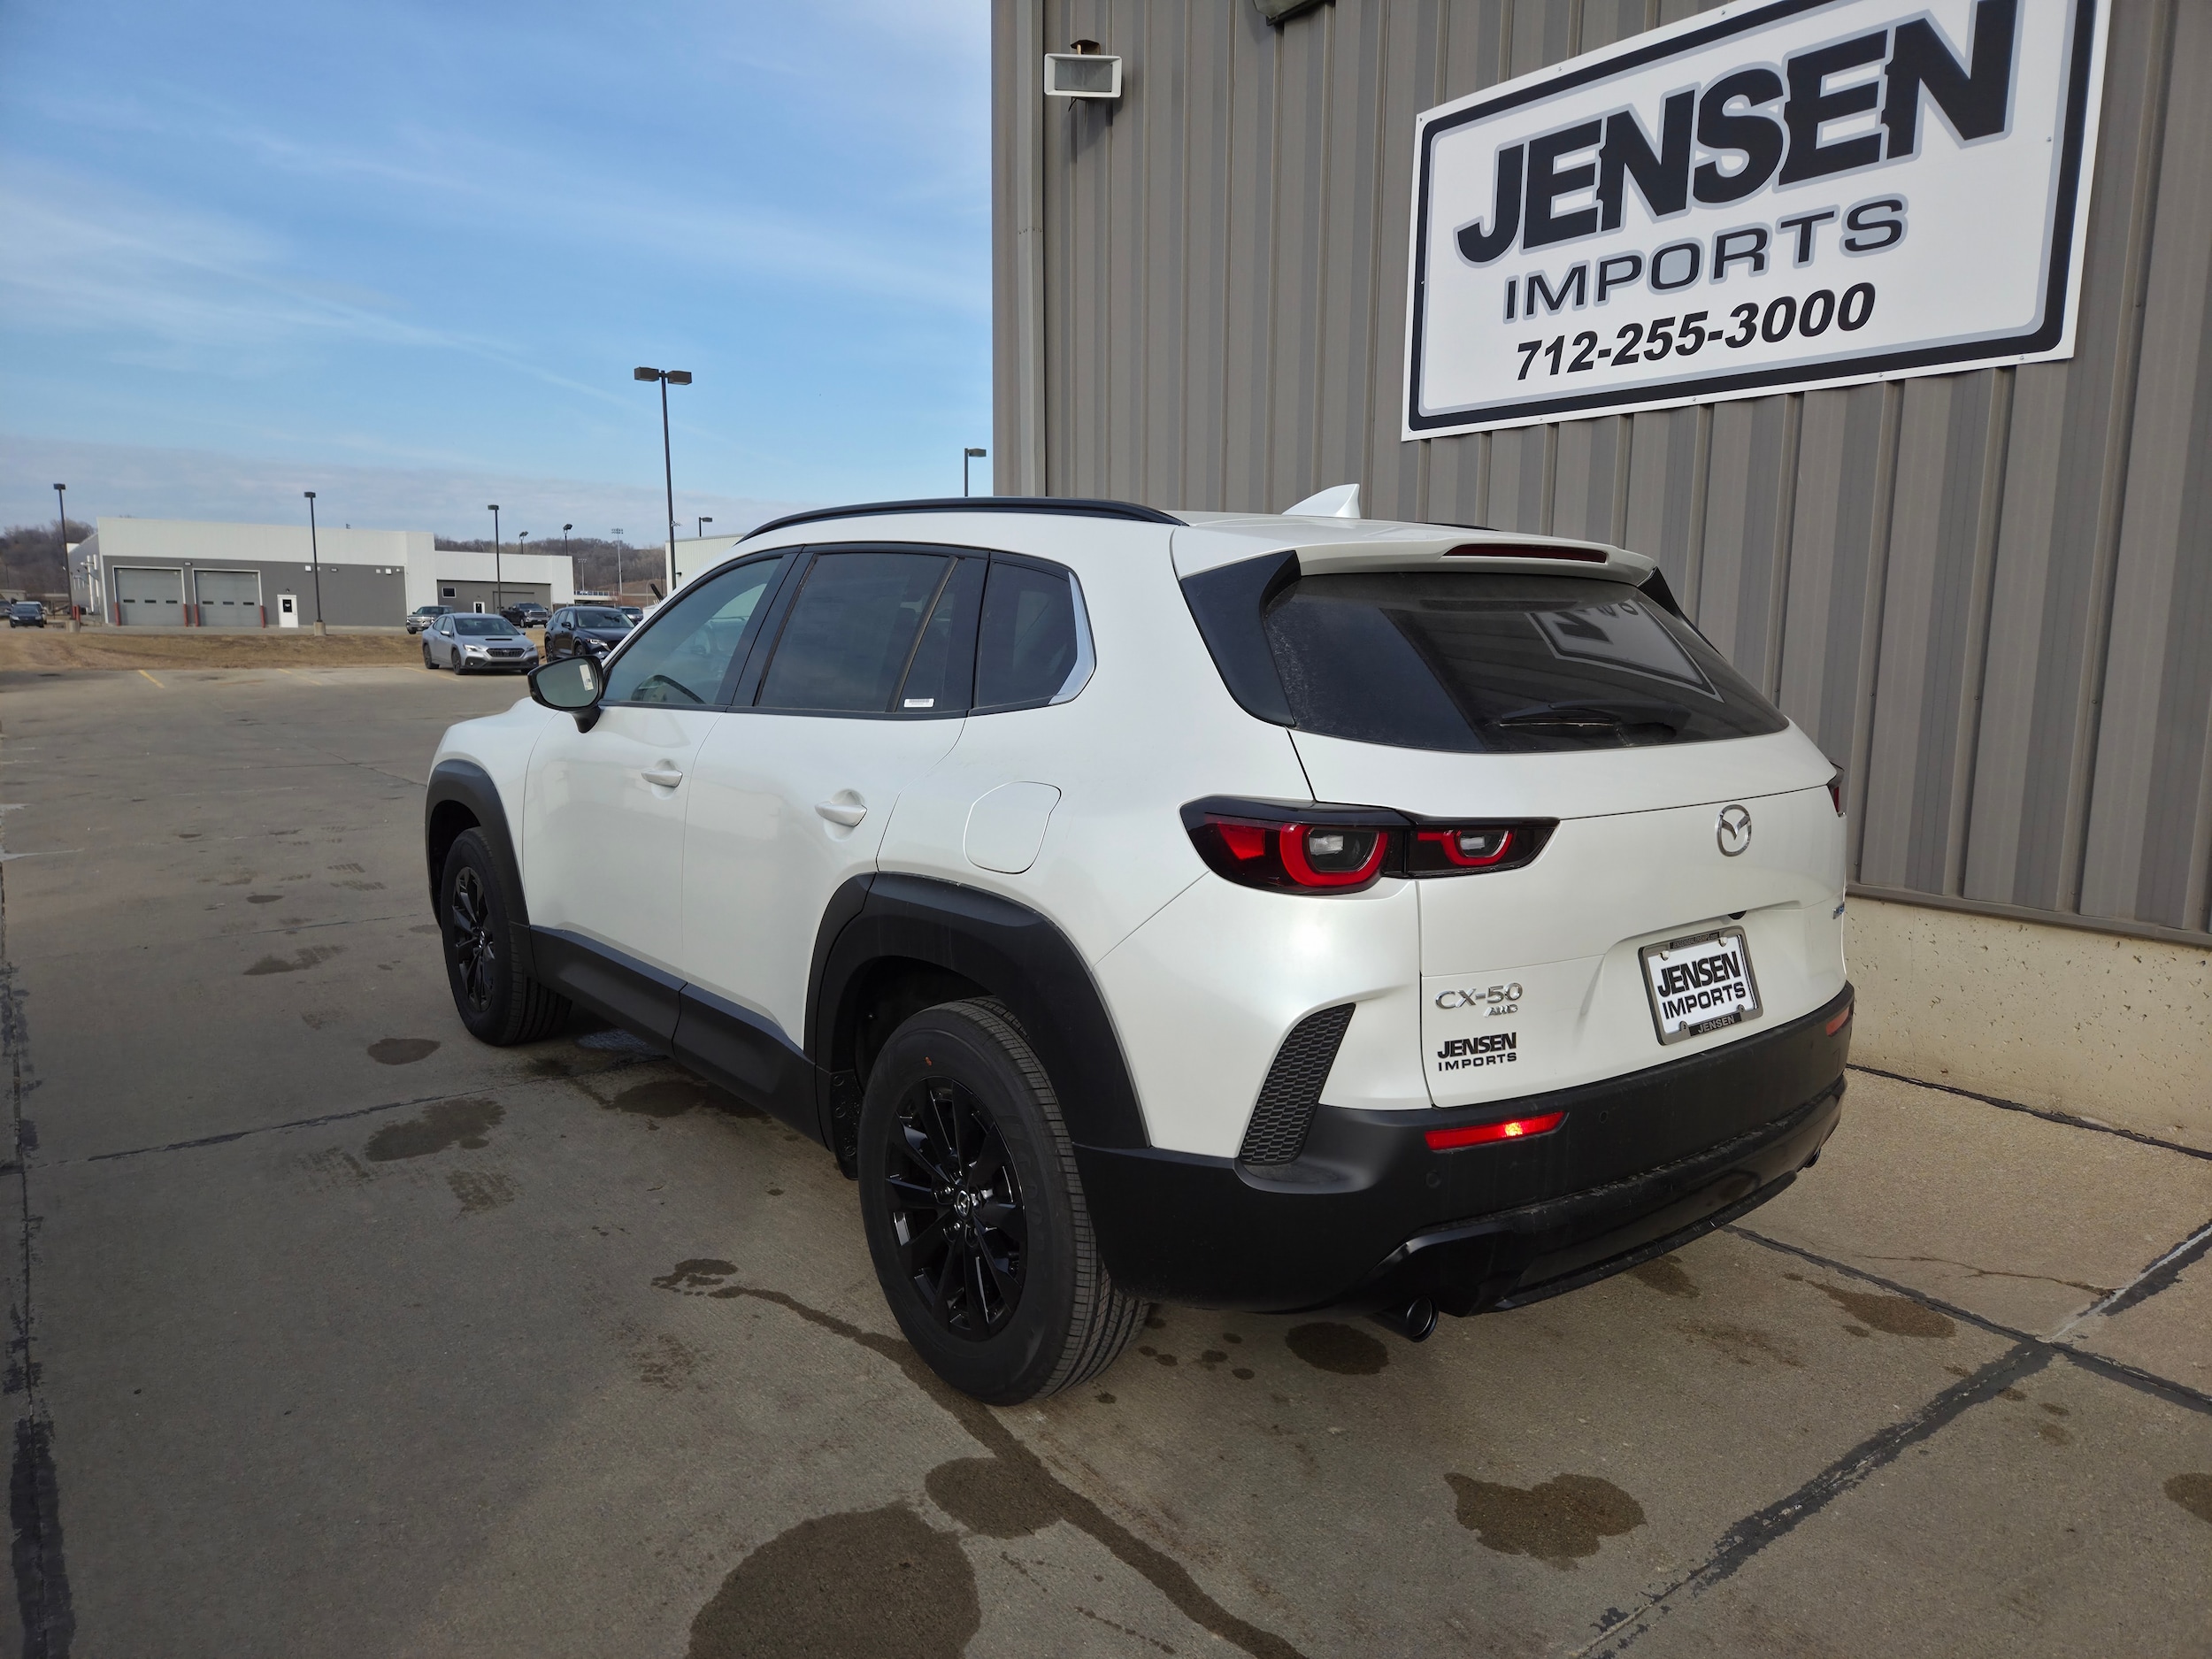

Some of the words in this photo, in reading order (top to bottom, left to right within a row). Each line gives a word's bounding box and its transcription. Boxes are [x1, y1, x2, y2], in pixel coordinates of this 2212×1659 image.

[1456, 0, 2017, 263] JENSEN
[1506, 199, 1904, 320] IMPORTS
[1516, 282, 1876, 380] 712-255-3000
[1657, 951, 1741, 997] JENSEN
[1435, 982, 1523, 1009] CX-50
[1483, 1004, 1518, 1018] AWD
[1663, 981, 1747, 1019] IMPORTS
[1698, 1016, 1735, 1033] JENSEN
[1437, 1032, 1517, 1059] JENSEN
[1438, 1052, 1517, 1071] IMPORTS
